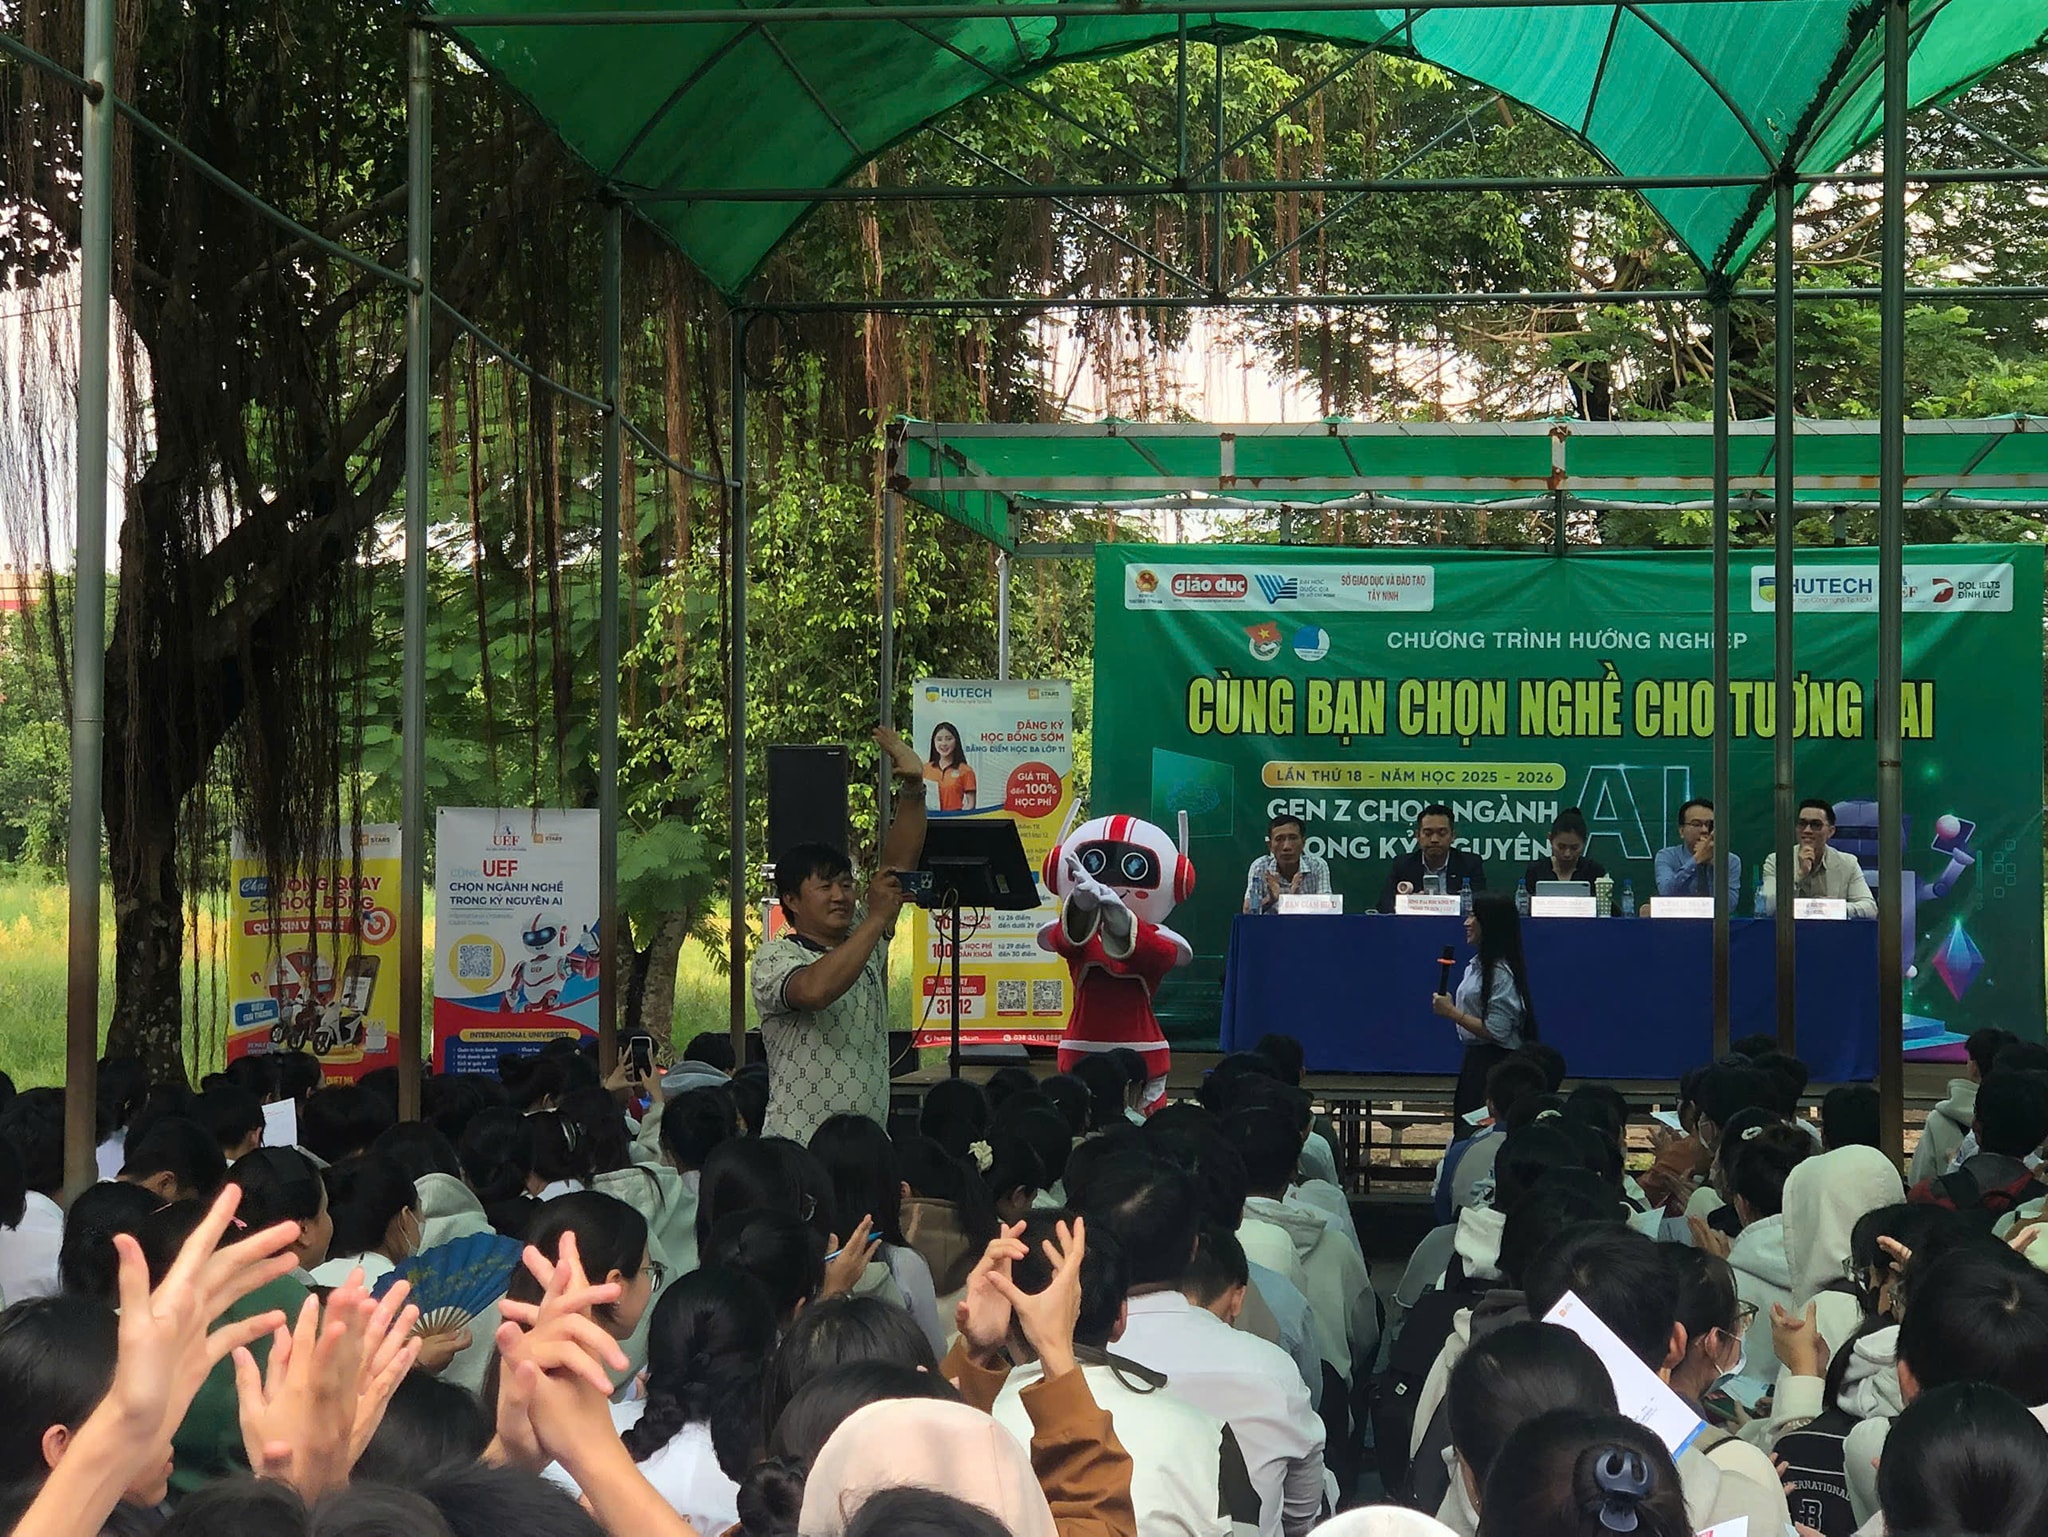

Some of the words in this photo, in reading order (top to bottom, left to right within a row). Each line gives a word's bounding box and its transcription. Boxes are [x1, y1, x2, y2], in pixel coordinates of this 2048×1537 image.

[1174, 575, 1212, 594] giáo
[1214, 577, 1245, 596] dục
[1341, 572, 1351, 586] SỞ
[1369, 575, 1385, 588] DỤC
[1385, 572, 1395, 586] VÀ
[1396, 573, 1411, 586] ĐÀO
[1412, 575, 1426, 588] TẠO
[1957, 582, 1977, 590] DOL
[1979, 581, 2000, 589] IELTS
[1368, 589, 1381, 601] TÂY
[1382, 591, 1399, 601] NINH
[1957, 590, 1981, 599] ĐÌNH
[1387, 629, 1485, 649] CHƯƠNG
[1493, 627, 1562, 649] TRÌNH
[1569, 627, 1651, 649] HƯỚNG
[941, 686, 992, 698] HUTECH
[1187, 669, 1297, 736] CÙNG
[1306, 678, 1386, 746] BẠN
[1397, 677, 1507, 747] CHỌN
[1519, 661, 1623, 737] NGHỀ
[1635, 679, 1715, 737] CHO
[1896, 681, 1935, 739] AI
[1016, 719, 1048, 730] ĐĂNG
[1051, 719, 1065, 730] KÝ
[980, 733, 1004, 744] HỌC
[1007, 730, 1038, 742] BỔNG
[1041, 731, 1064, 742] SỚM
[1010, 745, 1028, 755] HỌC
[1058, 745, 1065, 753] 11
[1017, 771, 1034, 781] GIÁ
[1036, 772, 1050, 783] TRỊ
[1312, 767, 1342, 782] THỨ
[1348, 770, 1362, 782] 18
[1381, 767, 1416, 782] NĂM
[1421, 770, 1456, 786] HỌC
[1461, 770, 1498, 783] 2025
[1517, 770, 1554, 783] 2026
[1010, 786, 1025, 794] đến
[1026, 783, 1058, 795] 100%
[1015, 797, 1036, 808] HỌC
[1037, 796, 1052, 806] PHÍ
[1266, 798, 1326, 823] GEN
[1333, 799, 1352, 822] Z
[1358, 798, 1445, 827] CHỌ
[1452, 794, 1558, 824] NGÀNH
[1577, 765, 1692, 860] AI
[493, 835, 520, 846] UEF
[1451, 831, 1553, 861] GUYÊN
[482, 859, 519, 878] UEF
[337, 875, 382, 891] QAY
[449, 882, 484, 894] CHỌN
[486, 880, 529, 893] NGÀNH
[449, 896, 487, 906] TRONG
[505, 894, 550, 906] NGUYÊN
[552, 897, 563, 906] AI
[965, 943, 980, 951] HỌC
[981, 941, 993, 950] PHÍ
[469, 1031, 527, 1039] INTERNATIONAL
[528, 1031, 570, 1039] UNIVERSITY
[1784, 1480, 1851, 1502] ERNATIONAL
